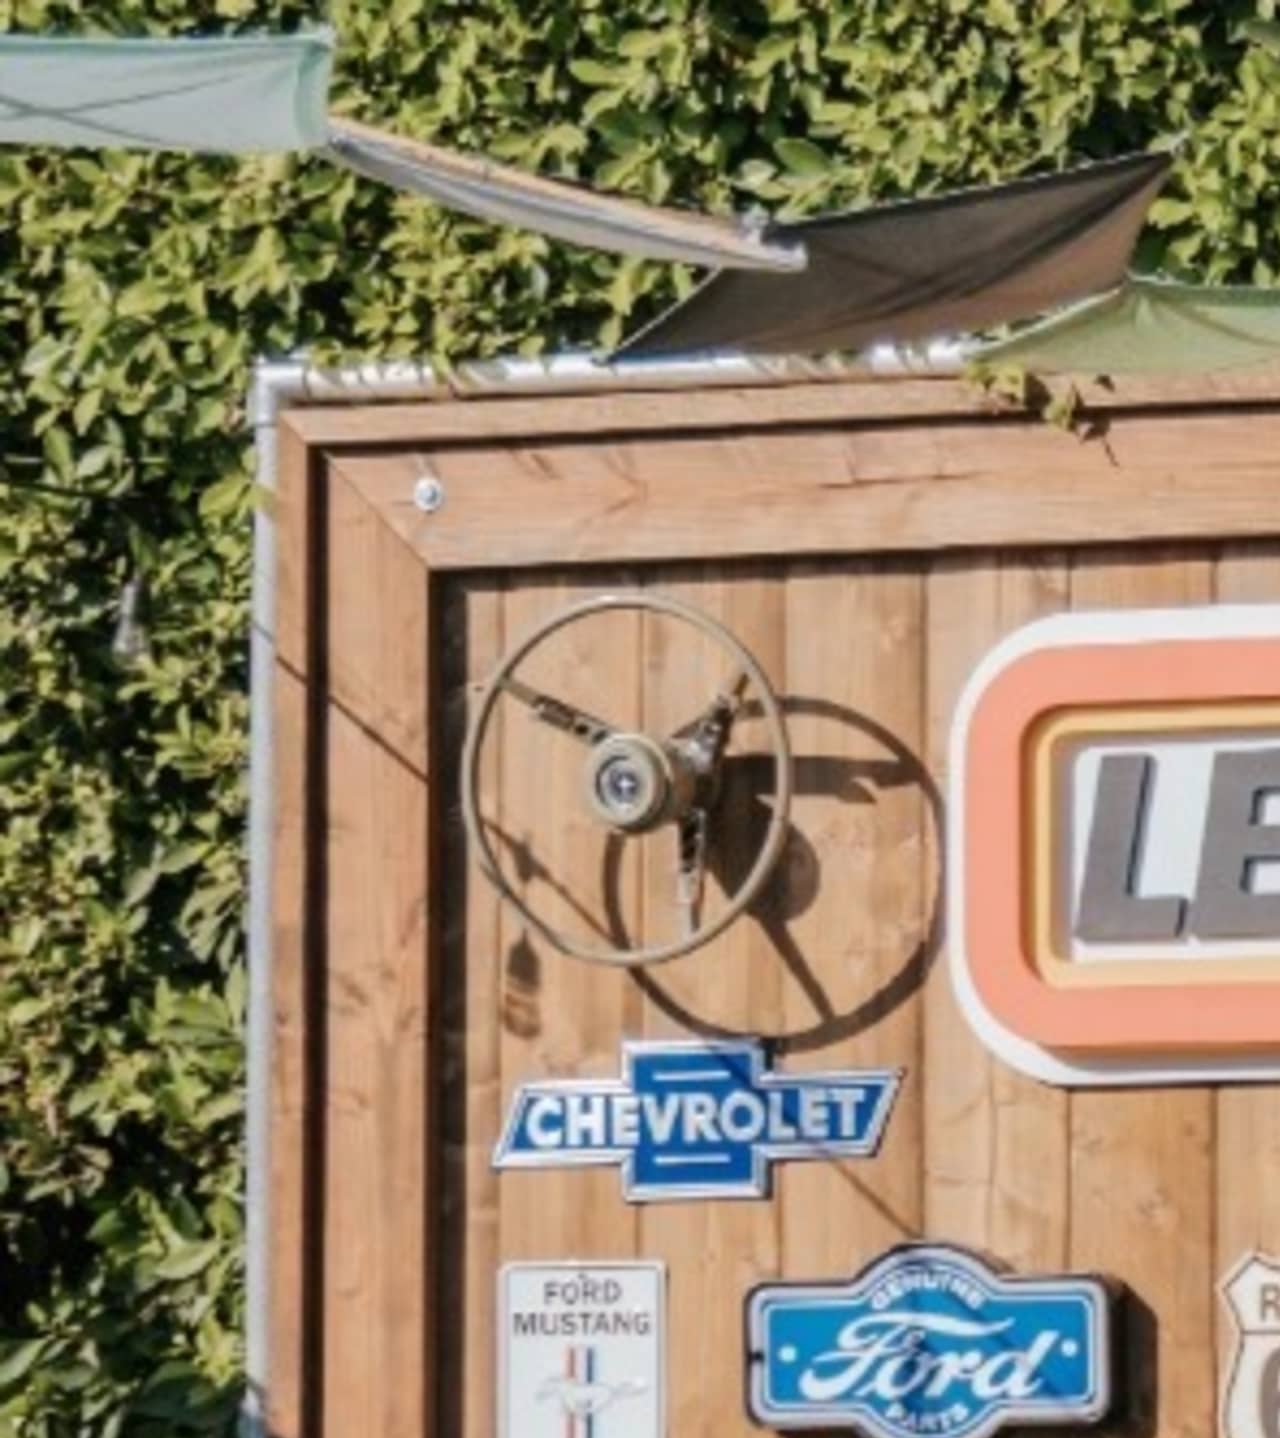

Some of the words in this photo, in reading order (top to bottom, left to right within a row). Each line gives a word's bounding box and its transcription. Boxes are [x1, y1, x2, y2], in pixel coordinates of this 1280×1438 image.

[526, 1088, 866, 1147] CHEVROLET
[542, 1279, 622, 1305] FORD
[513, 1311, 652, 1336] MUSTANG
[800, 1310, 1060, 1399] Ford
